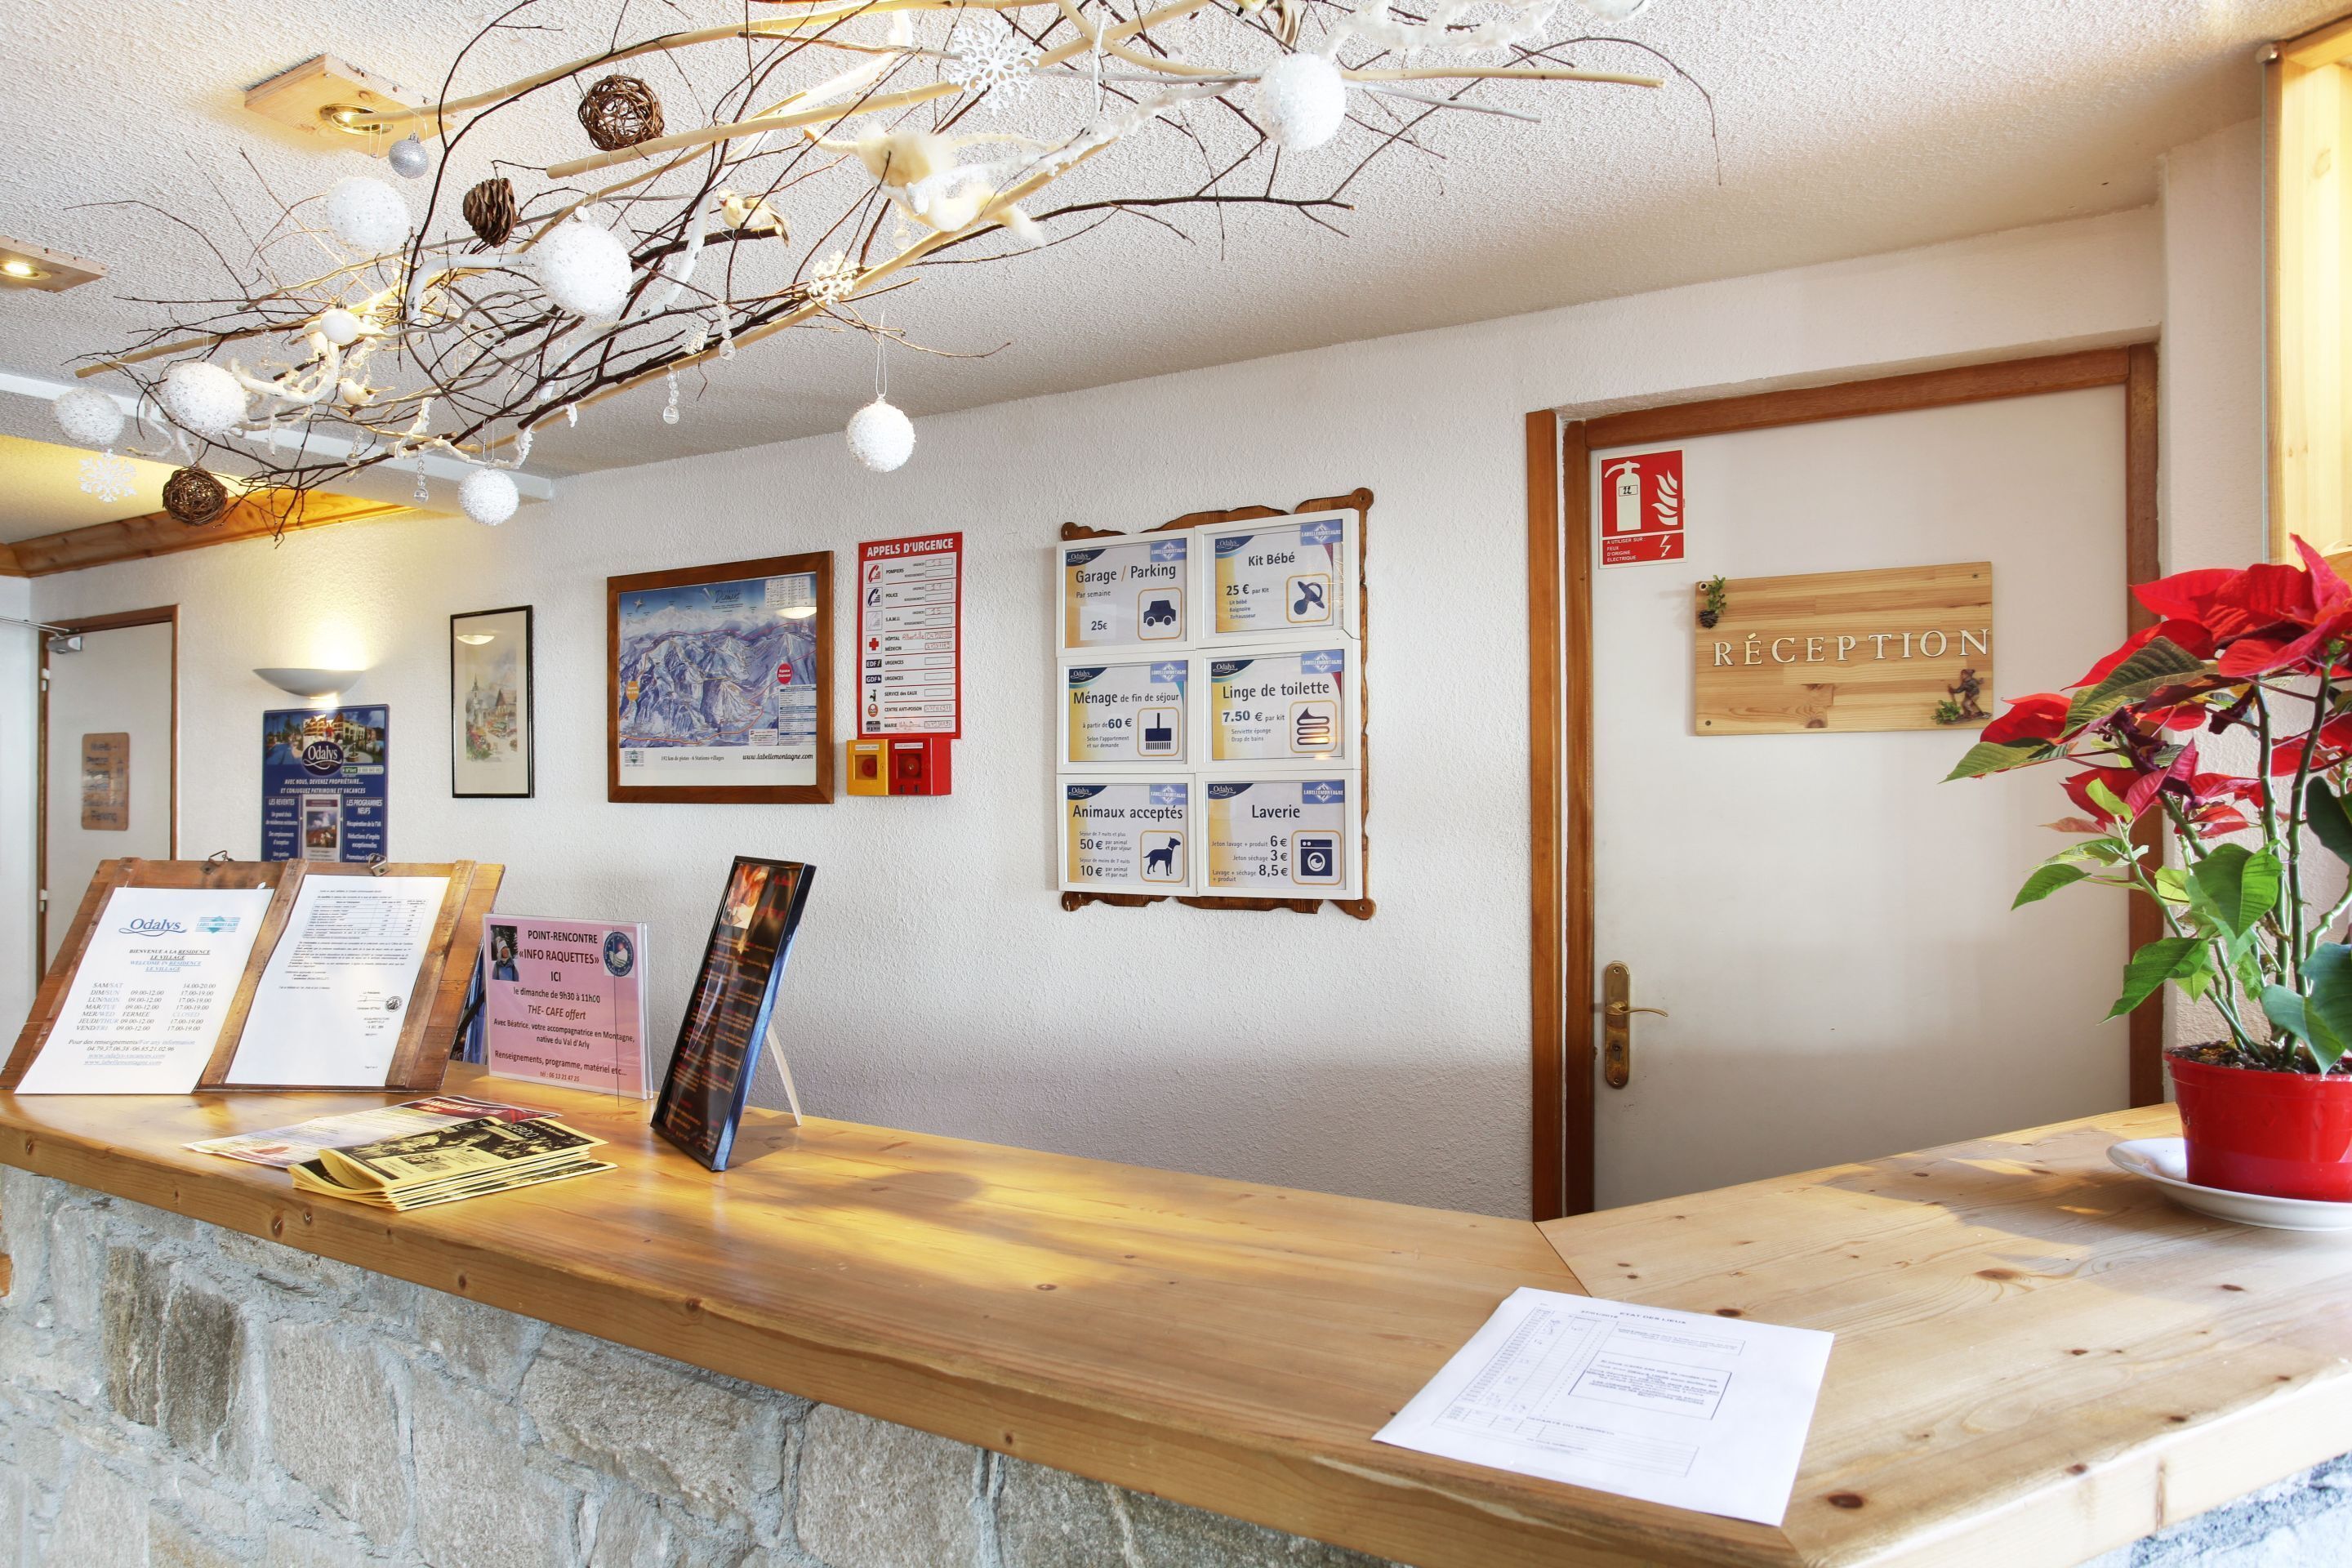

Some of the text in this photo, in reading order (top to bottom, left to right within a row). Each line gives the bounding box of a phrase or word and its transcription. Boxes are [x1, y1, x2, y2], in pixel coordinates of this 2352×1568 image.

[867, 538, 953, 557] APPELS D'URGENCE
[1248, 552, 1295, 566] Kit Bébé
[1076, 570, 1117, 584] Garage
[1130, 564, 1176, 579] Parking
[1226, 585, 1239, 596] 25
[1242, 584, 1250, 595] €
[1091, 621, 1107, 630] 25€
[1713, 628, 1989, 666] RÉCEPTION
[1223, 682, 1330, 701] Linge de toilette
[1073, 692, 1117, 706] Ménage
[1132, 694, 1142, 702] fin
[1156, 693, 1179, 703] séjour
[1223, 710, 1250, 723] 7.50
[1255, 712, 1263, 721] €
[1087, 722, 1101, 730] partir
[1108, 719, 1122, 728] 60
[1125, 719, 1132, 727] €
[308, 746, 338, 761] Odalys
[1213, 786, 1233, 795] Odalys
[1072, 804, 1183, 822] Animaux acceptés
[1252, 804, 1300, 818] Laverie
[1080, 839, 1102, 849] 50 €
[1270, 835, 1277, 846] 6
[1281, 838, 1287, 846] €
[1271, 849, 1277, 861] 3
[1281, 853, 1287, 861] €
[1080, 866, 1102, 876] 10 €
[1258, 865, 1279, 877] 8,5
[1281, 867, 1288, 876] €
[130, 918, 181, 932] Odalys
[528, 930, 598, 944] POINT-RENCONTRE
[519, 949, 599, 964] «INFO RAQUETTES»
[550, 971, 561, 982] ICI
[514, 987, 600, 1004] le dimanche de 9h30 à 11h00
[528, 1005, 586, 1021] THE- CAFE offert
[494, 1018, 506, 1027] Avec
[507, 1020, 531, 1030] Béatrice,
[546, 1025, 594, 1037] accompagnatrice
[603, 1031, 635, 1043] Montagne,
[555, 1036, 562, 1045] du
[564, 1038, 572, 1046] Val
[573, 1039, 590, 1049] d'Arly
[495, 1050, 544, 1065] Renseignements,
[545, 1059, 582, 1071] programme,
[584, 1063, 610, 1073] matériel
